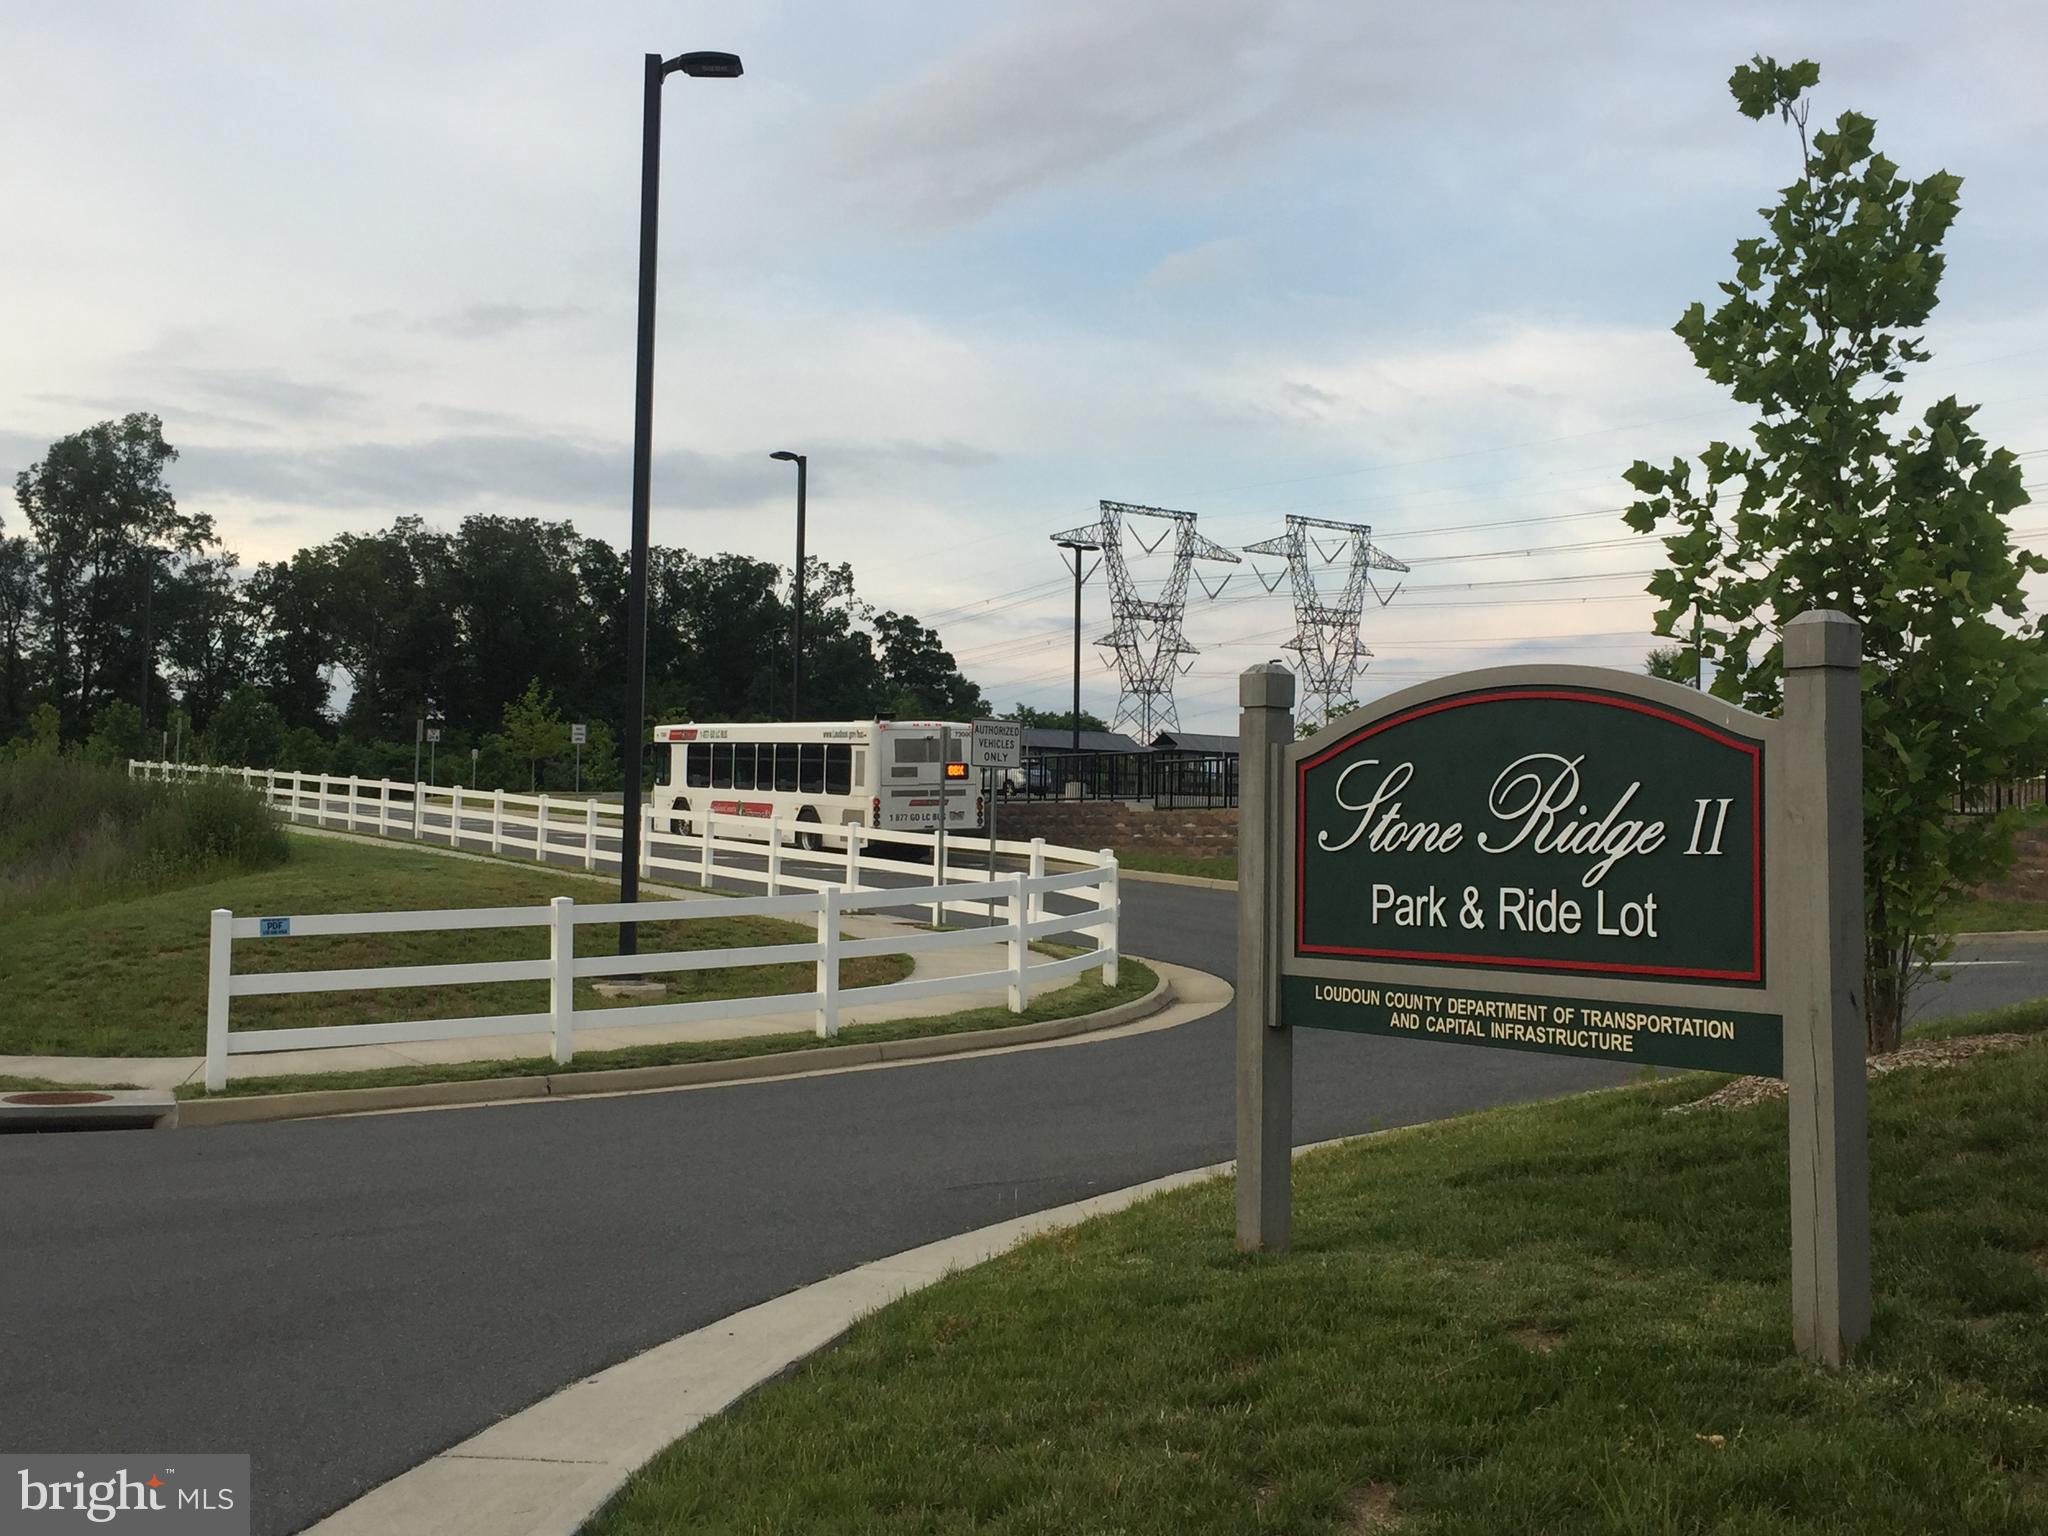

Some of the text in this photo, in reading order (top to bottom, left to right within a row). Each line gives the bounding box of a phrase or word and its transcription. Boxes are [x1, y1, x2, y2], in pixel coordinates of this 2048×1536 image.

[975, 725, 1020, 737] AUTHORIZED
[979, 739, 1015, 749] VEHICLES
[984, 752, 1009, 762] ONLY
[1318, 753, 1734, 888] Stone Ridge II
[1372, 884, 1658, 938] Park & Ride Lot
[1315, 985, 1735, 1040] LOUDOUN COUNTY DEPARTMENT OF TRANSPORTATION
[1390, 1012, 1634, 1052] AND CAPITAL INFRASTRUCTURE
